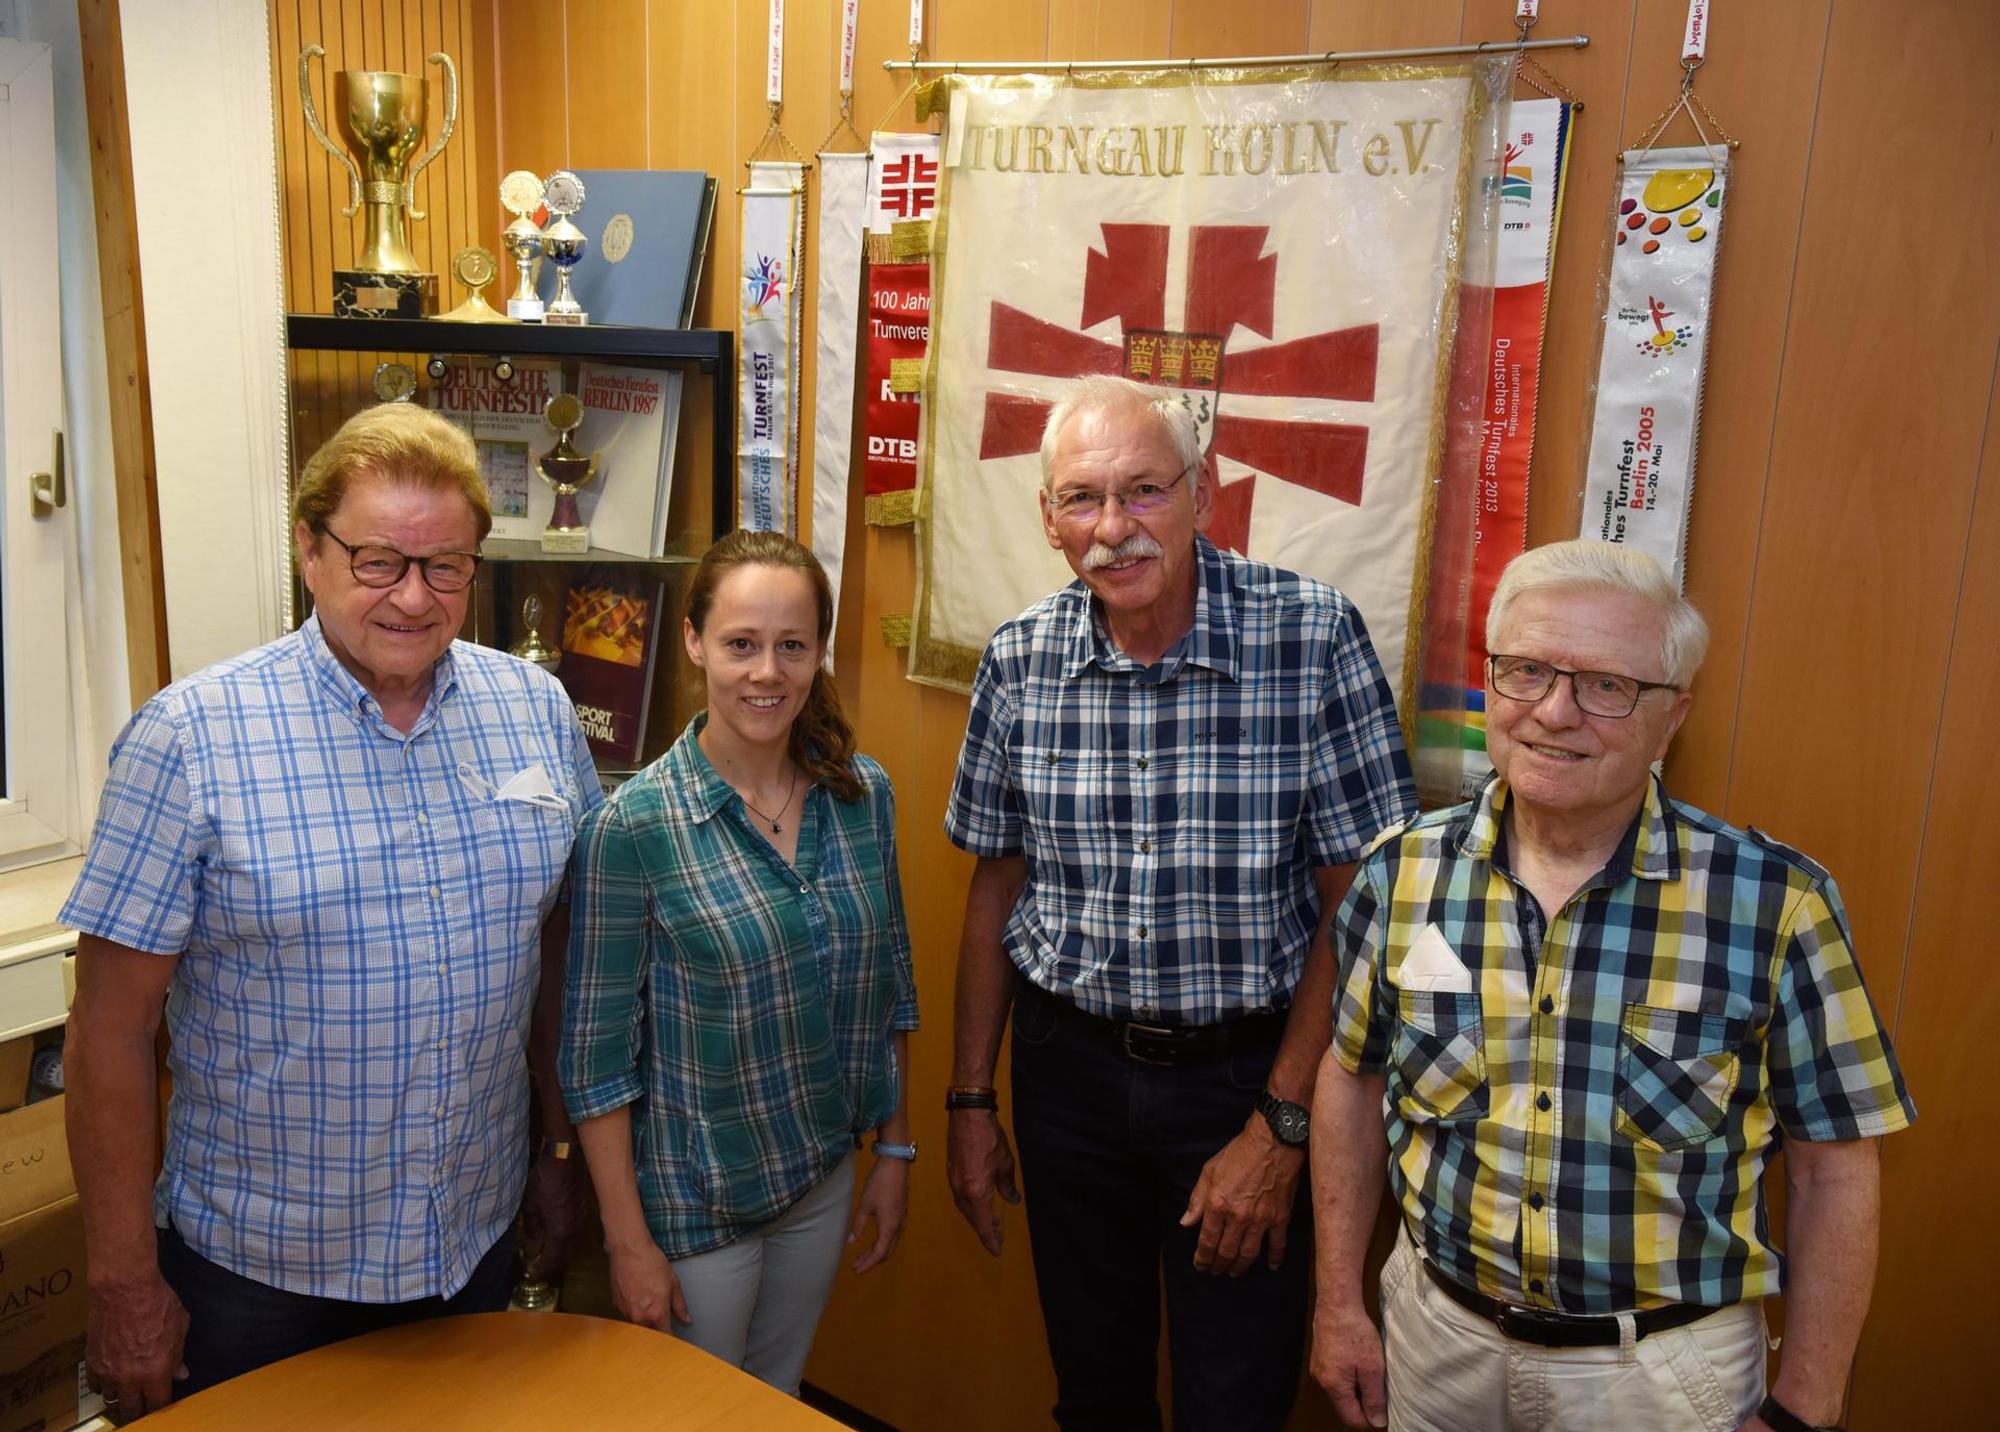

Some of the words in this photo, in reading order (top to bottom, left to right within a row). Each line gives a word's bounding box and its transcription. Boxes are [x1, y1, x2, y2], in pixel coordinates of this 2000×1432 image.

[967, 121, 1187, 178] TURNGAU
[1363, 117, 1441, 177] e.V.
[1504, 222, 1524, 231] DTB
[873, 290, 898, 309] 100
[767, 353, 775, 373] 2017
[1494, 338, 1511, 415] Deutsches
[583, 388, 631, 413] BERLIN
[633, 395, 659, 416] 1987
[753, 352, 768, 439] TURNFEST
[1508, 364, 1521, 438] Internationales
[868, 436, 917, 458] DTB
[1485, 419, 1508, 478] Turnfest
[1637, 406, 1655, 453] 2005
[1614, 439, 1635, 508] Turnfest
[1652, 445, 1663, 467] Mai
[759, 448, 772, 533] DEUTSCHES
[1485, 479, 1498, 513] 2013
[1629, 459, 1649, 510] Berlin
[1646, 468, 1660, 511] 14.-20.
[575, 704, 613, 726] SPORT
